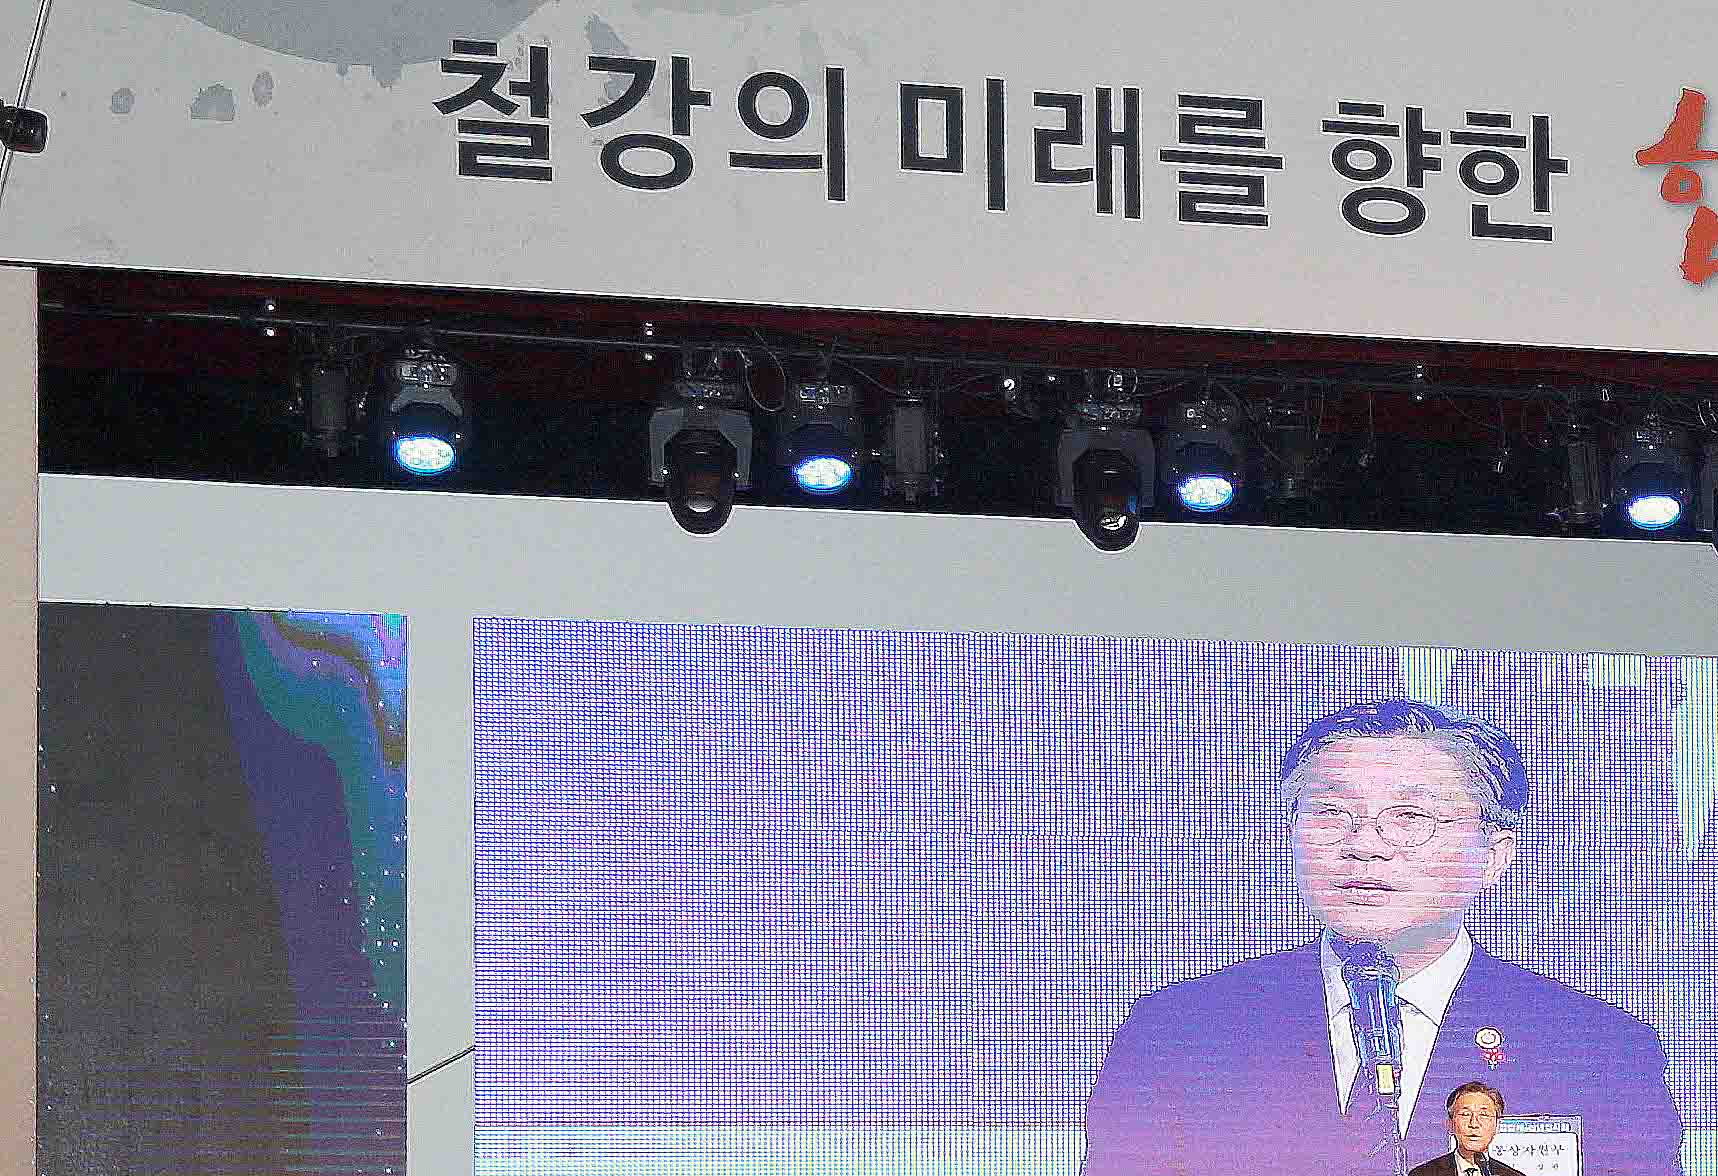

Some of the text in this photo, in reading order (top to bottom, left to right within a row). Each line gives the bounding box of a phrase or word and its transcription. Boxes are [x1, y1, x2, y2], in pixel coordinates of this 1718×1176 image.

[432, 40, 845, 201] 철강의
[899, 78, 1284, 226] 미래를
[1321, 101, 1568, 241] 향한
